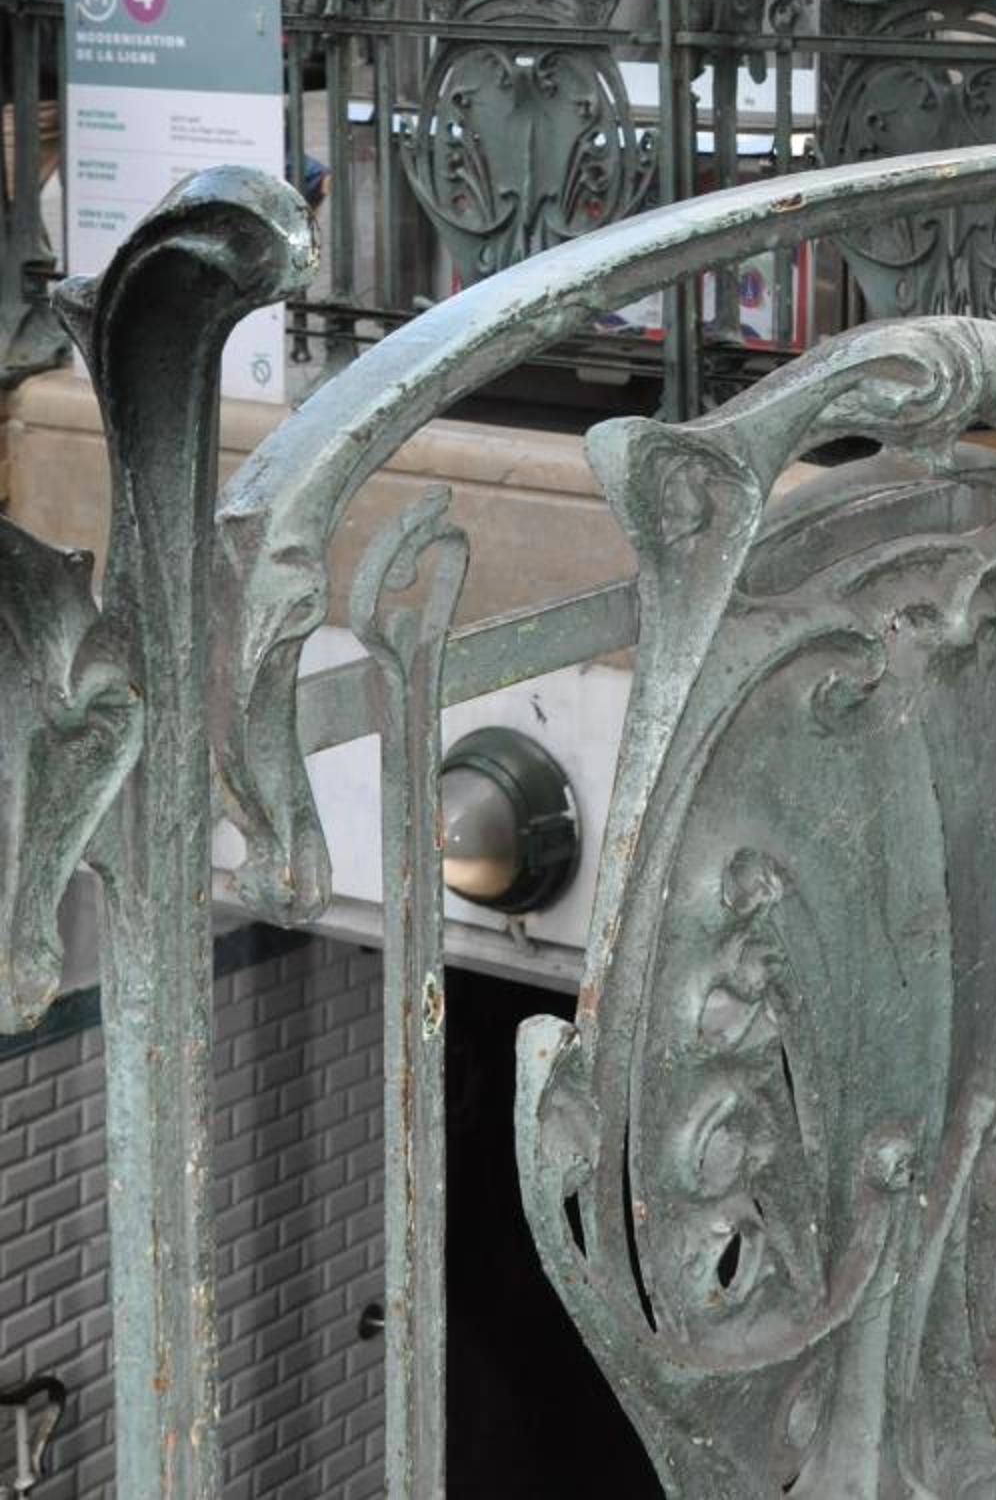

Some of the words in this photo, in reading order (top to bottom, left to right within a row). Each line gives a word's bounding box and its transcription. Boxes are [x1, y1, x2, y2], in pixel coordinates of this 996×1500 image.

[76, 31, 188, 48] MODERNISATION
[76, 48, 93, 62] DE
[96, 50, 113, 63] LA
[117, 51, 157, 65] LIGNE
